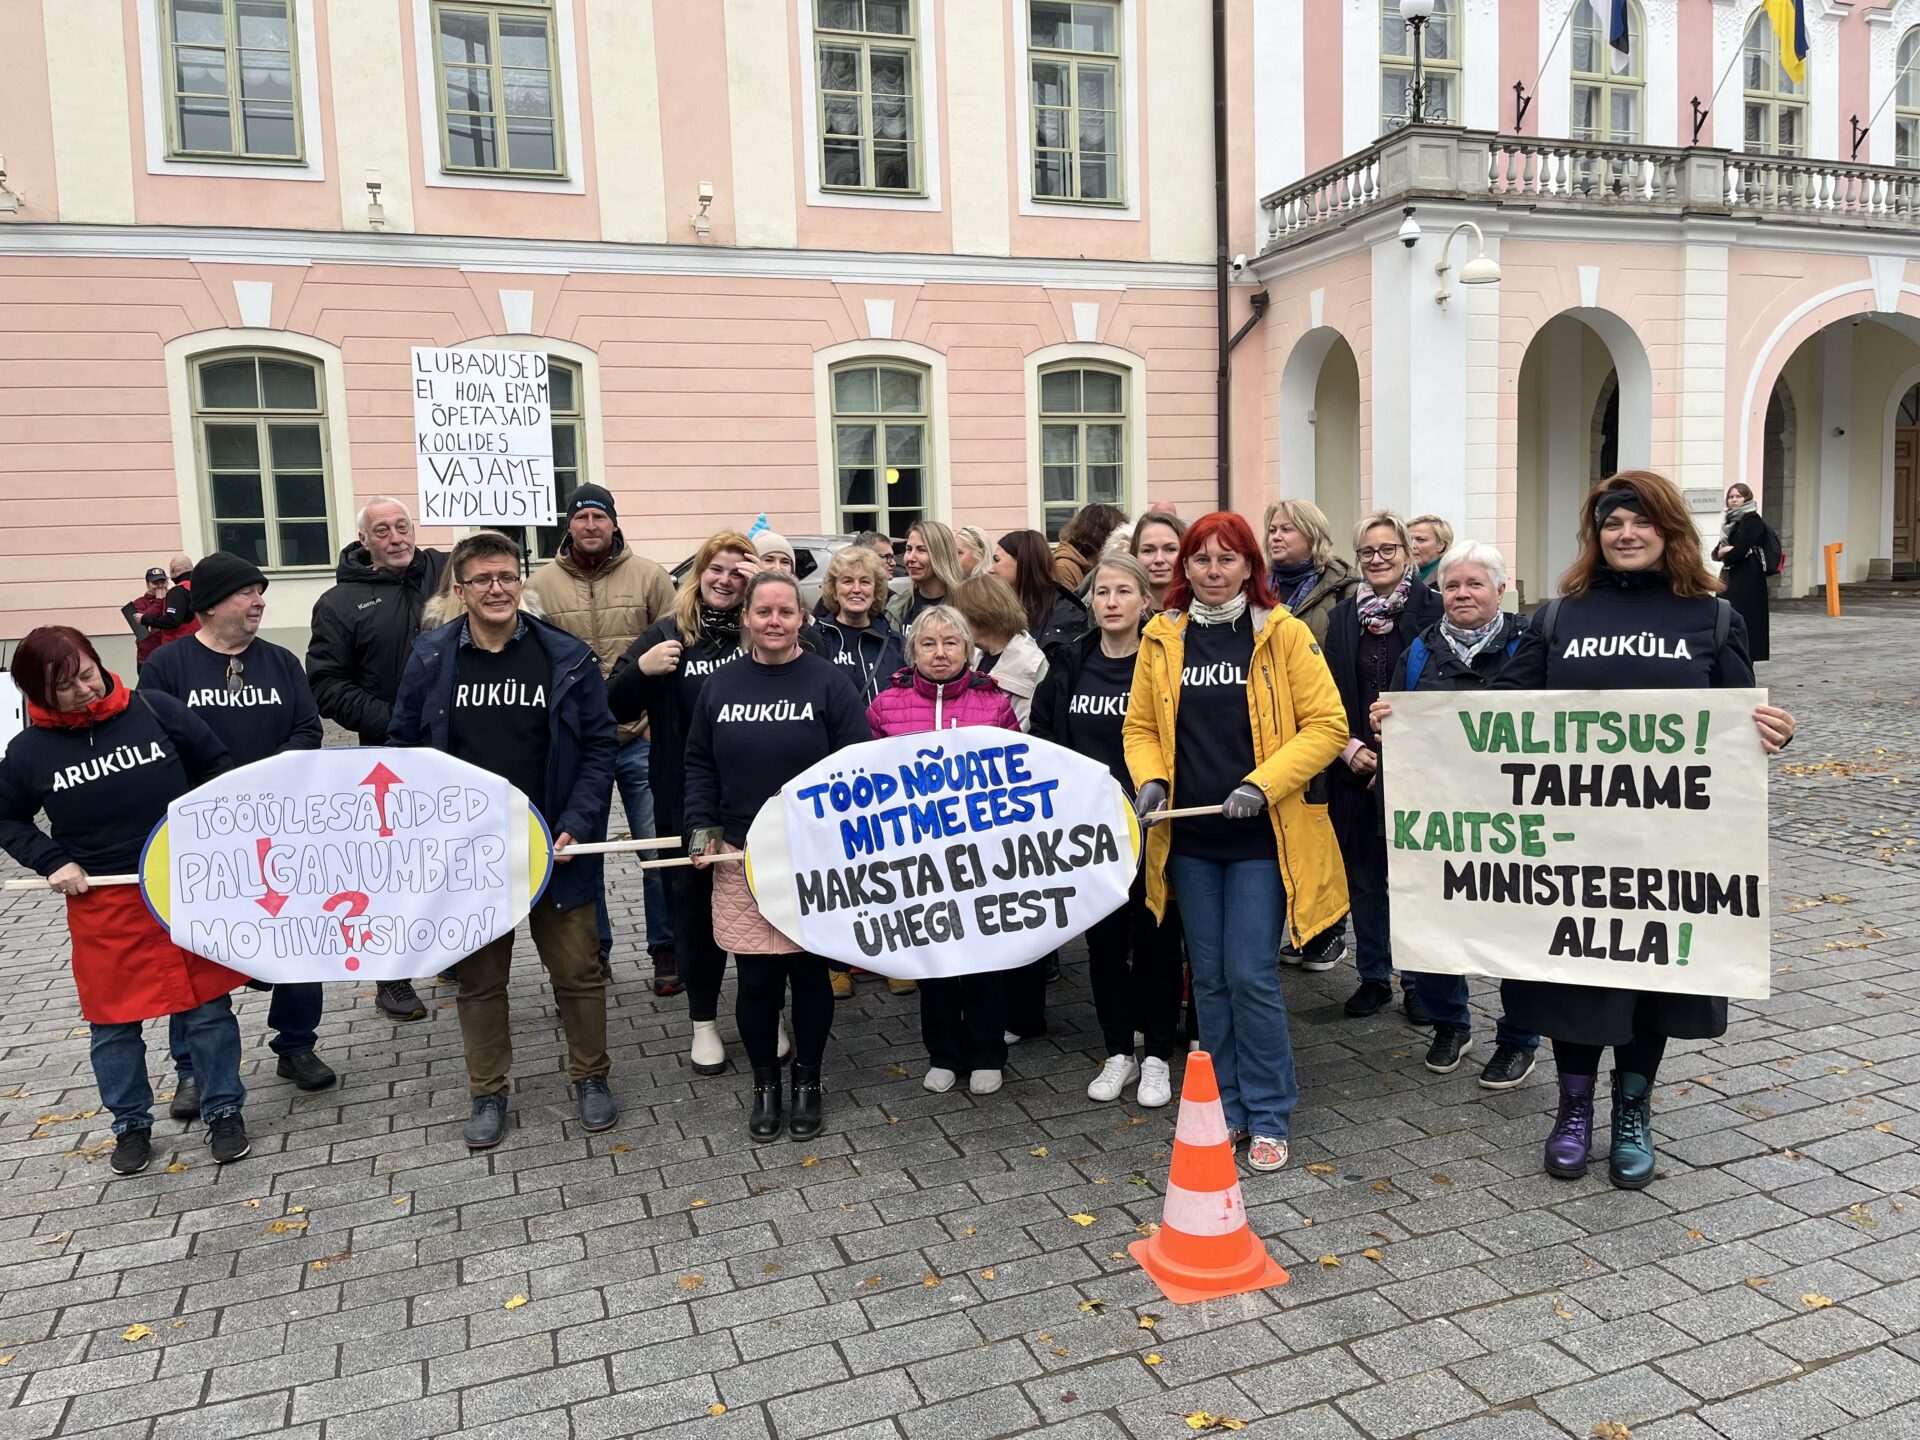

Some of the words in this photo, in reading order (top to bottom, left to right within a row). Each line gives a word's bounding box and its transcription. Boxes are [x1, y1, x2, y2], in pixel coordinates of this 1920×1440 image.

[416, 352, 547, 379] LUBADUSED
[416, 379, 434, 400] EI
[456, 381, 495, 403] HOIA
[505, 382, 549, 404] ENAM
[431, 403, 541, 427] ÕPETAJAID
[419, 432, 509, 453] KOOLIDES
[428, 457, 545, 487] VAJAME
[425, 485, 552, 522] KINDLUST!
[1563, 631, 1692, 660] ARUKÜLA
[455, 678, 547, 708] RUKÜLA
[1180, 661, 1248, 687] RUKÜL
[187, 685, 282, 708] ARUKÜLA
[716, 699, 815, 723] ARUKÜLA
[1069, 692, 1132, 716] ARUKÜ
[1458, 710, 1711, 755] VALITSUS!
[52, 741, 167, 792] ARUKÜLA
[797, 767, 898, 819] TÖÖD
[898, 743, 1032, 799] NÕUATE
[1500, 763, 1712, 810] TAHAME
[178, 785, 489, 839] TÖÖÜLESANDED
[1393, 810, 1575, 857] KAITSE-
[178, 834, 506, 903] PALGANUMBER
[795, 853, 944, 916] MAKSTA
[944, 843, 987, 892] EI
[992, 823, 1119, 880] JAKSA
[1443, 860, 1760, 918] MINISTEERIUMI
[190, 906, 496, 962] MOTIVATSIOON
[853, 899, 965, 957] ÜHEGI
[975, 886, 1077, 936] EEST
[1548, 916, 1693, 966] ALLA!
